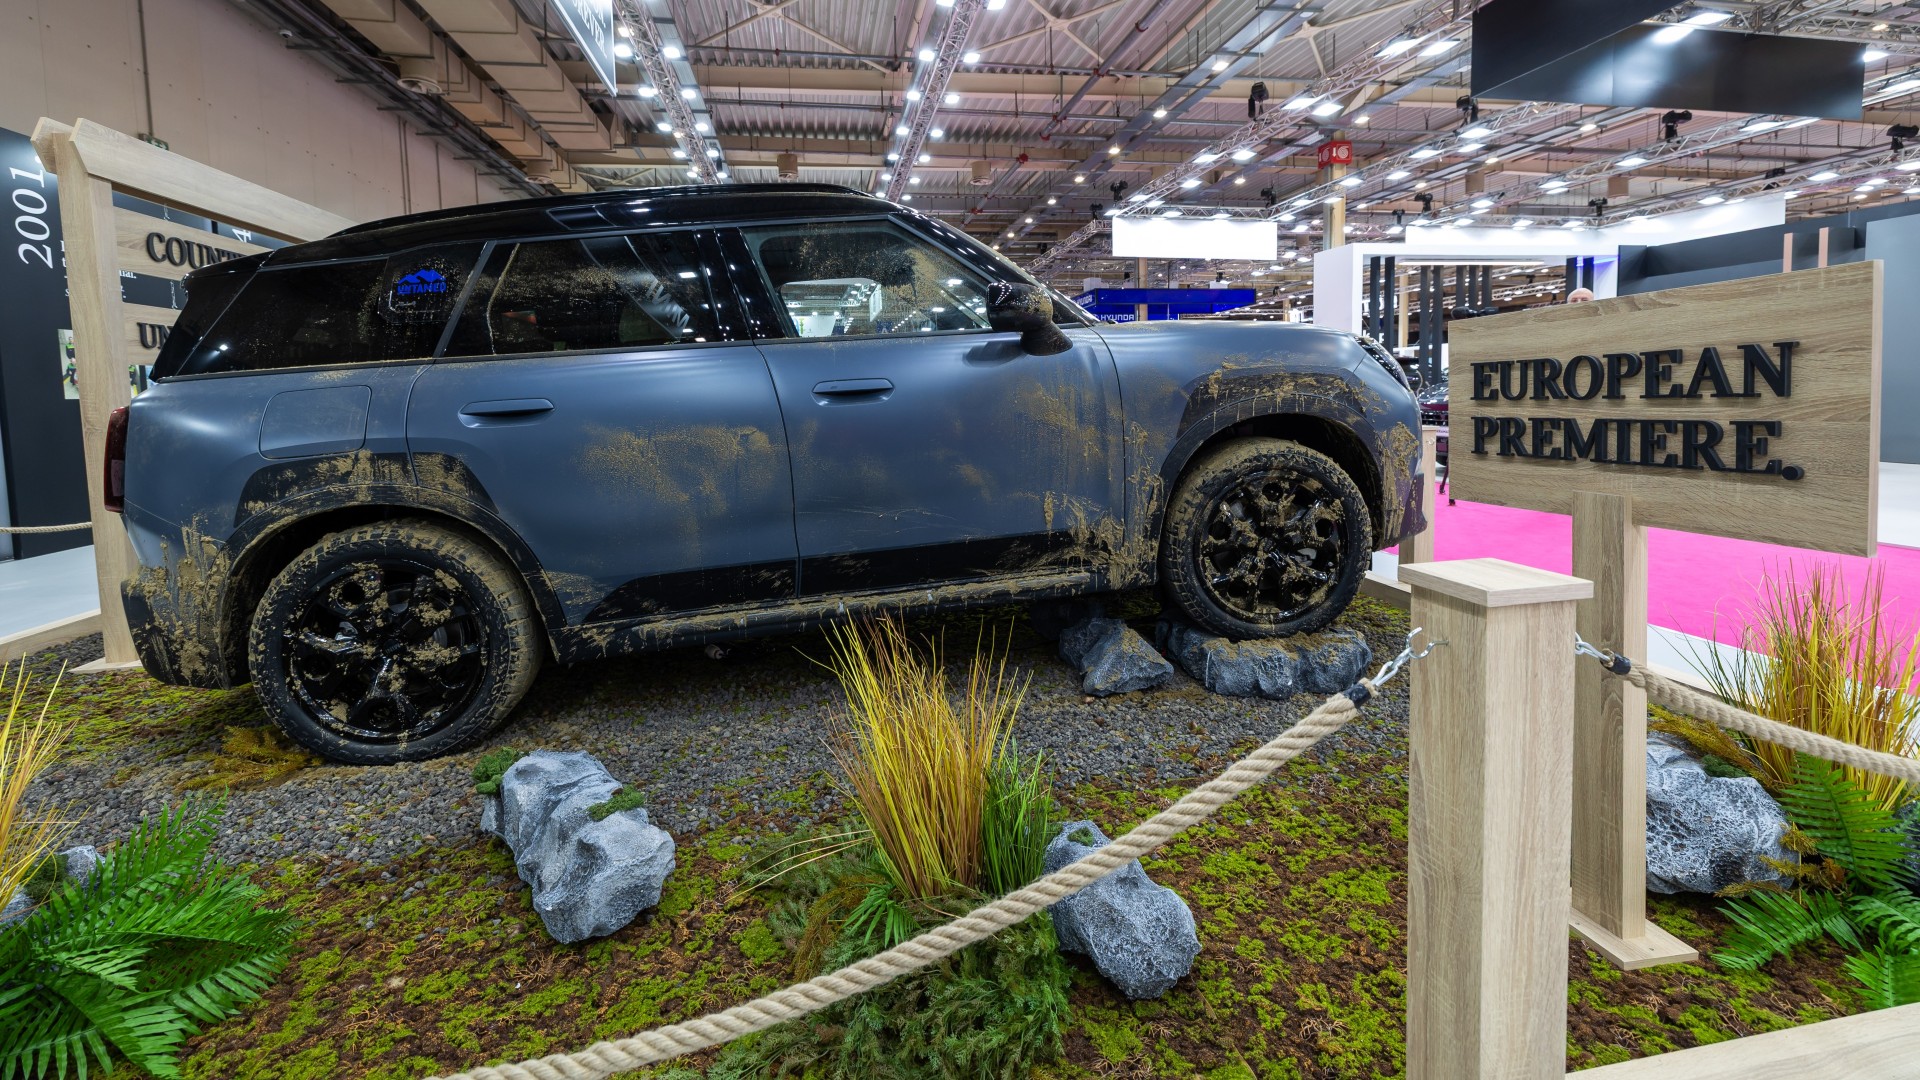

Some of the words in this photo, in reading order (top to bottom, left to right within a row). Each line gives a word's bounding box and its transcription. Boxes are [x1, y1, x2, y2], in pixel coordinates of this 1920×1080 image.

[9, 166, 54, 269] 2001
[1470, 341, 1800, 401] EUROPEAN
[1471, 416, 1805, 481] PREMIERE.
